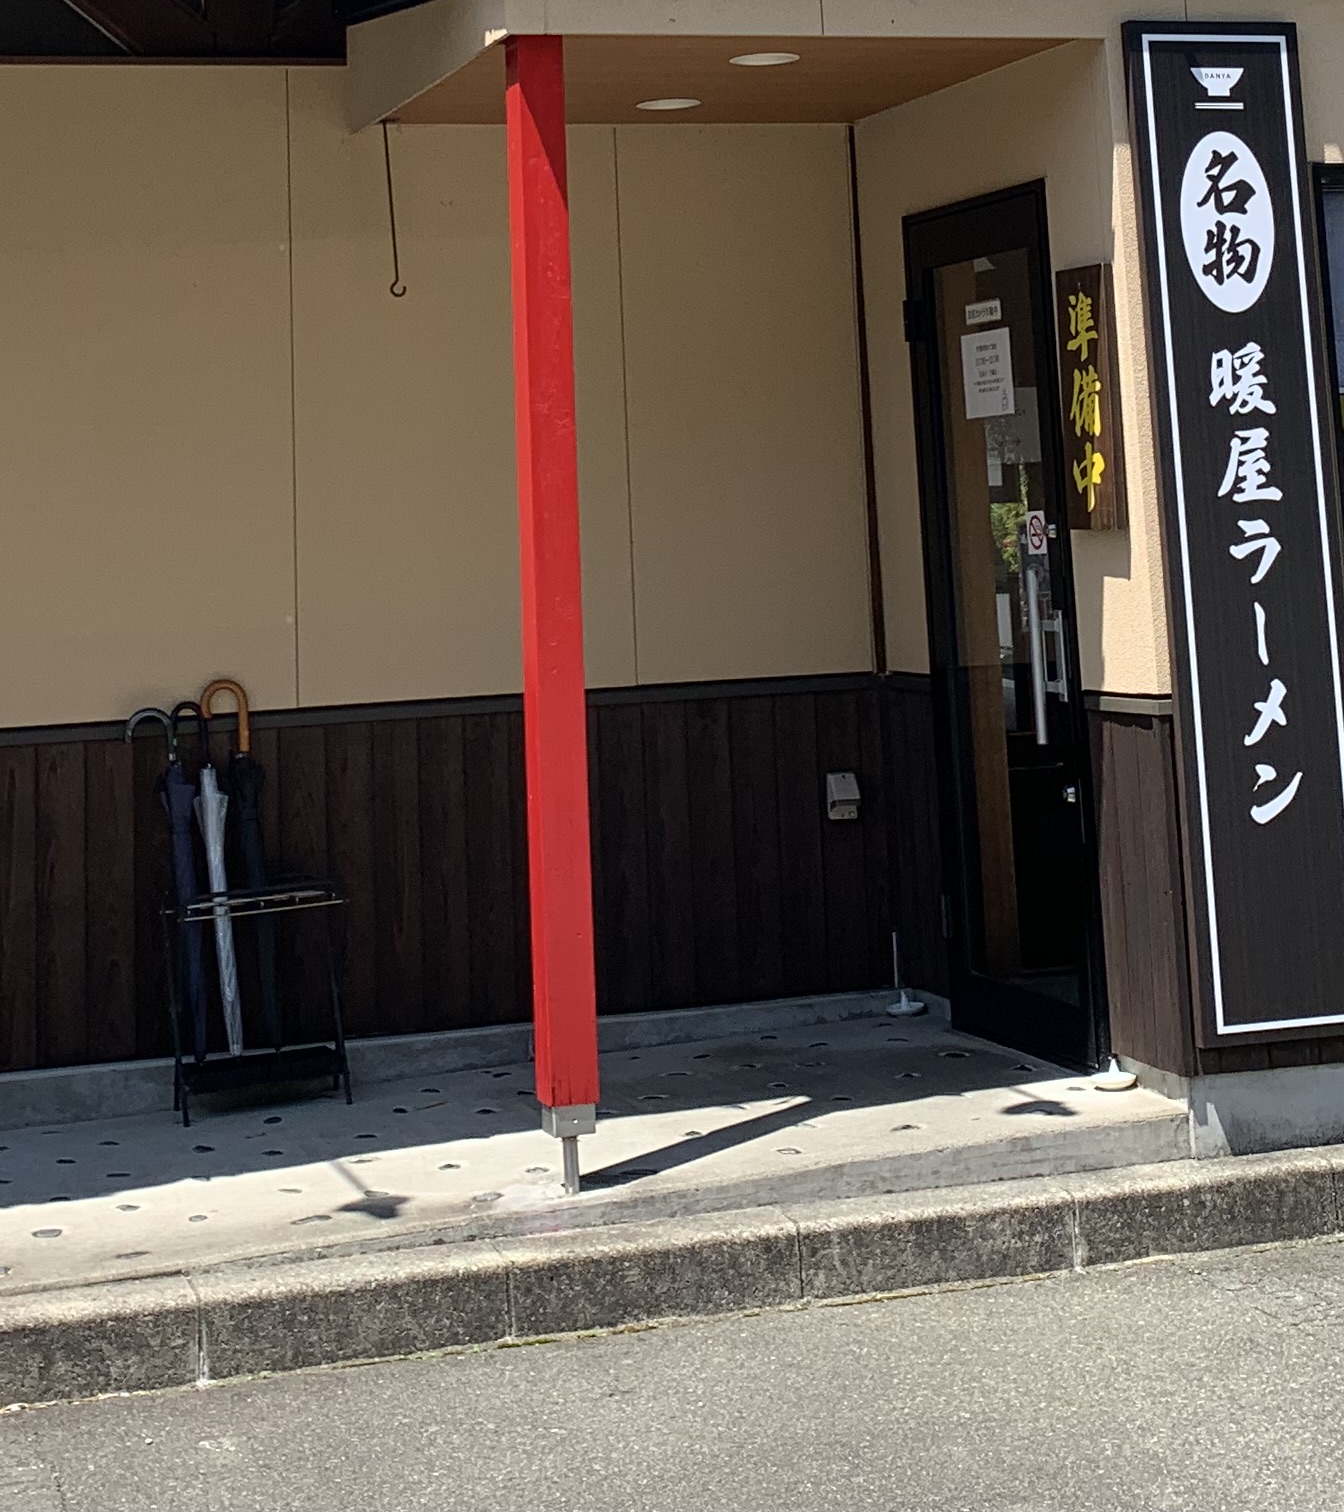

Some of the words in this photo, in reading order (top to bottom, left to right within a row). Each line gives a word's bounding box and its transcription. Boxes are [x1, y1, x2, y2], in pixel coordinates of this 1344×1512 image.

[1204, 72, 1232, 80] DANYA
[1196, 149, 1262, 286] 名物
[1066, 291, 1106, 514] 準備中
[1208, 341, 1304, 825] 暖屋ラーメン
